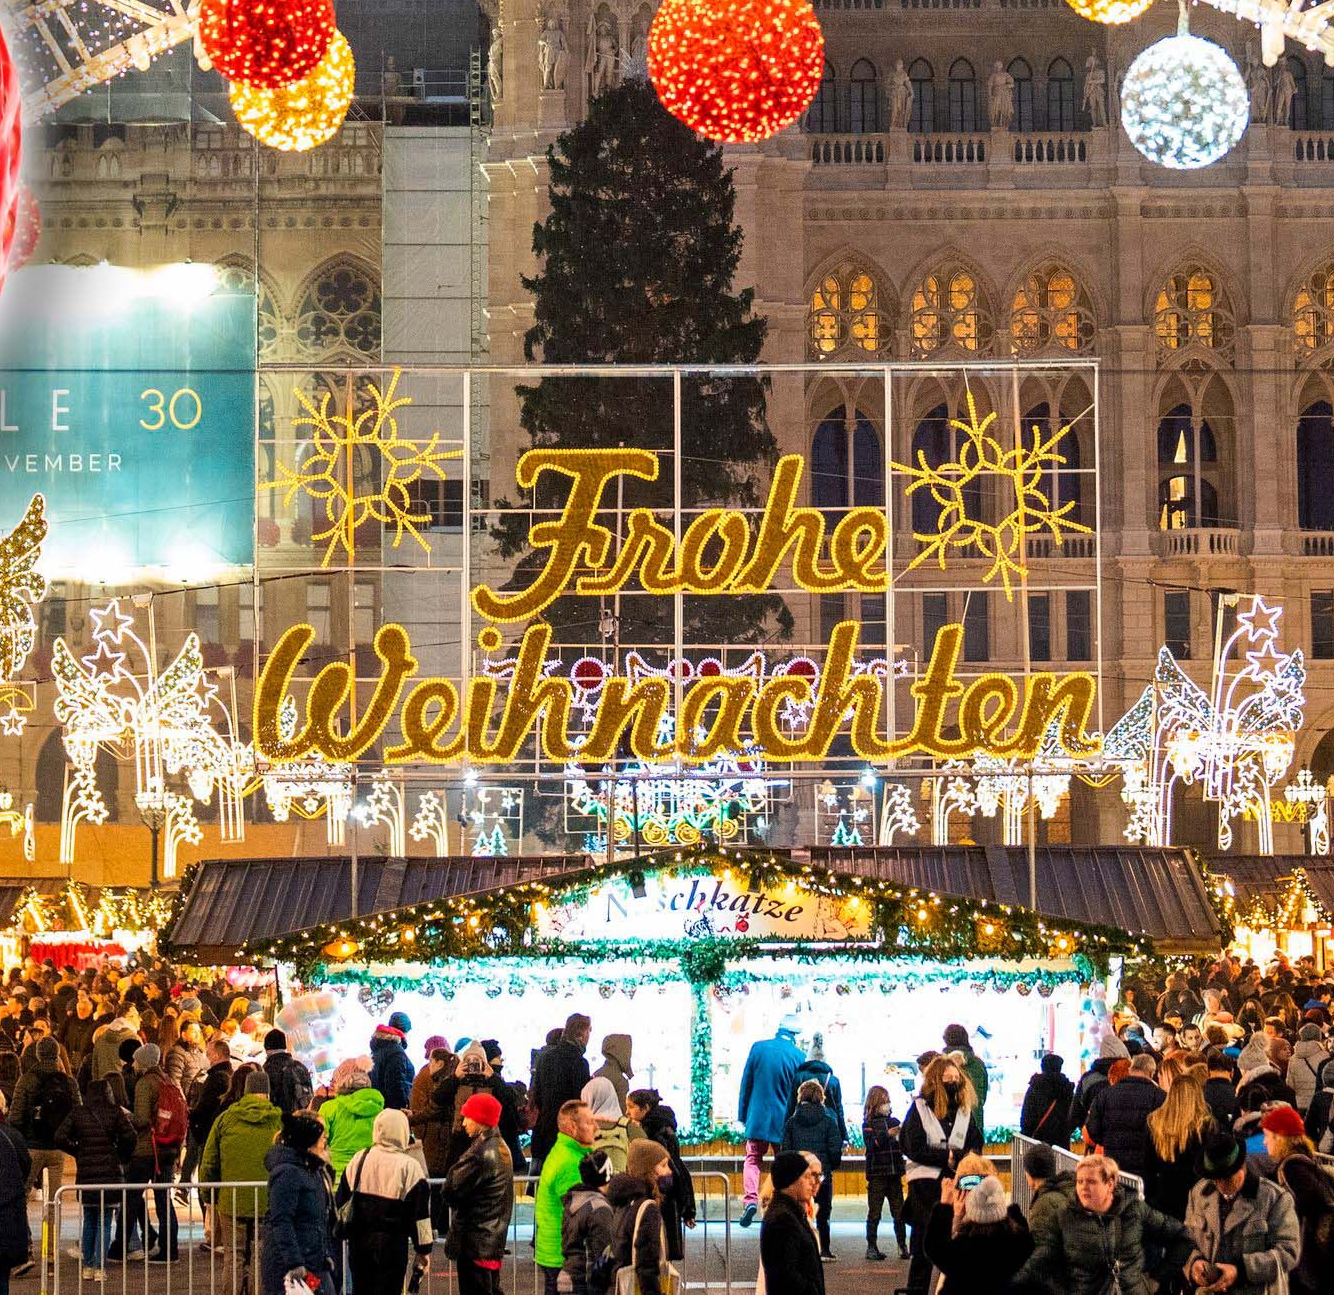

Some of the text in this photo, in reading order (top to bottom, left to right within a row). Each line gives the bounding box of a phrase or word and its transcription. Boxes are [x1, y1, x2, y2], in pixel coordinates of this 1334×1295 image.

[139, 388, 203, 431] 30
[472, 448, 891, 623] Frohe
[252, 620, 1103, 764] Weihnachten
[605, 878, 804, 923] Nschkatze
